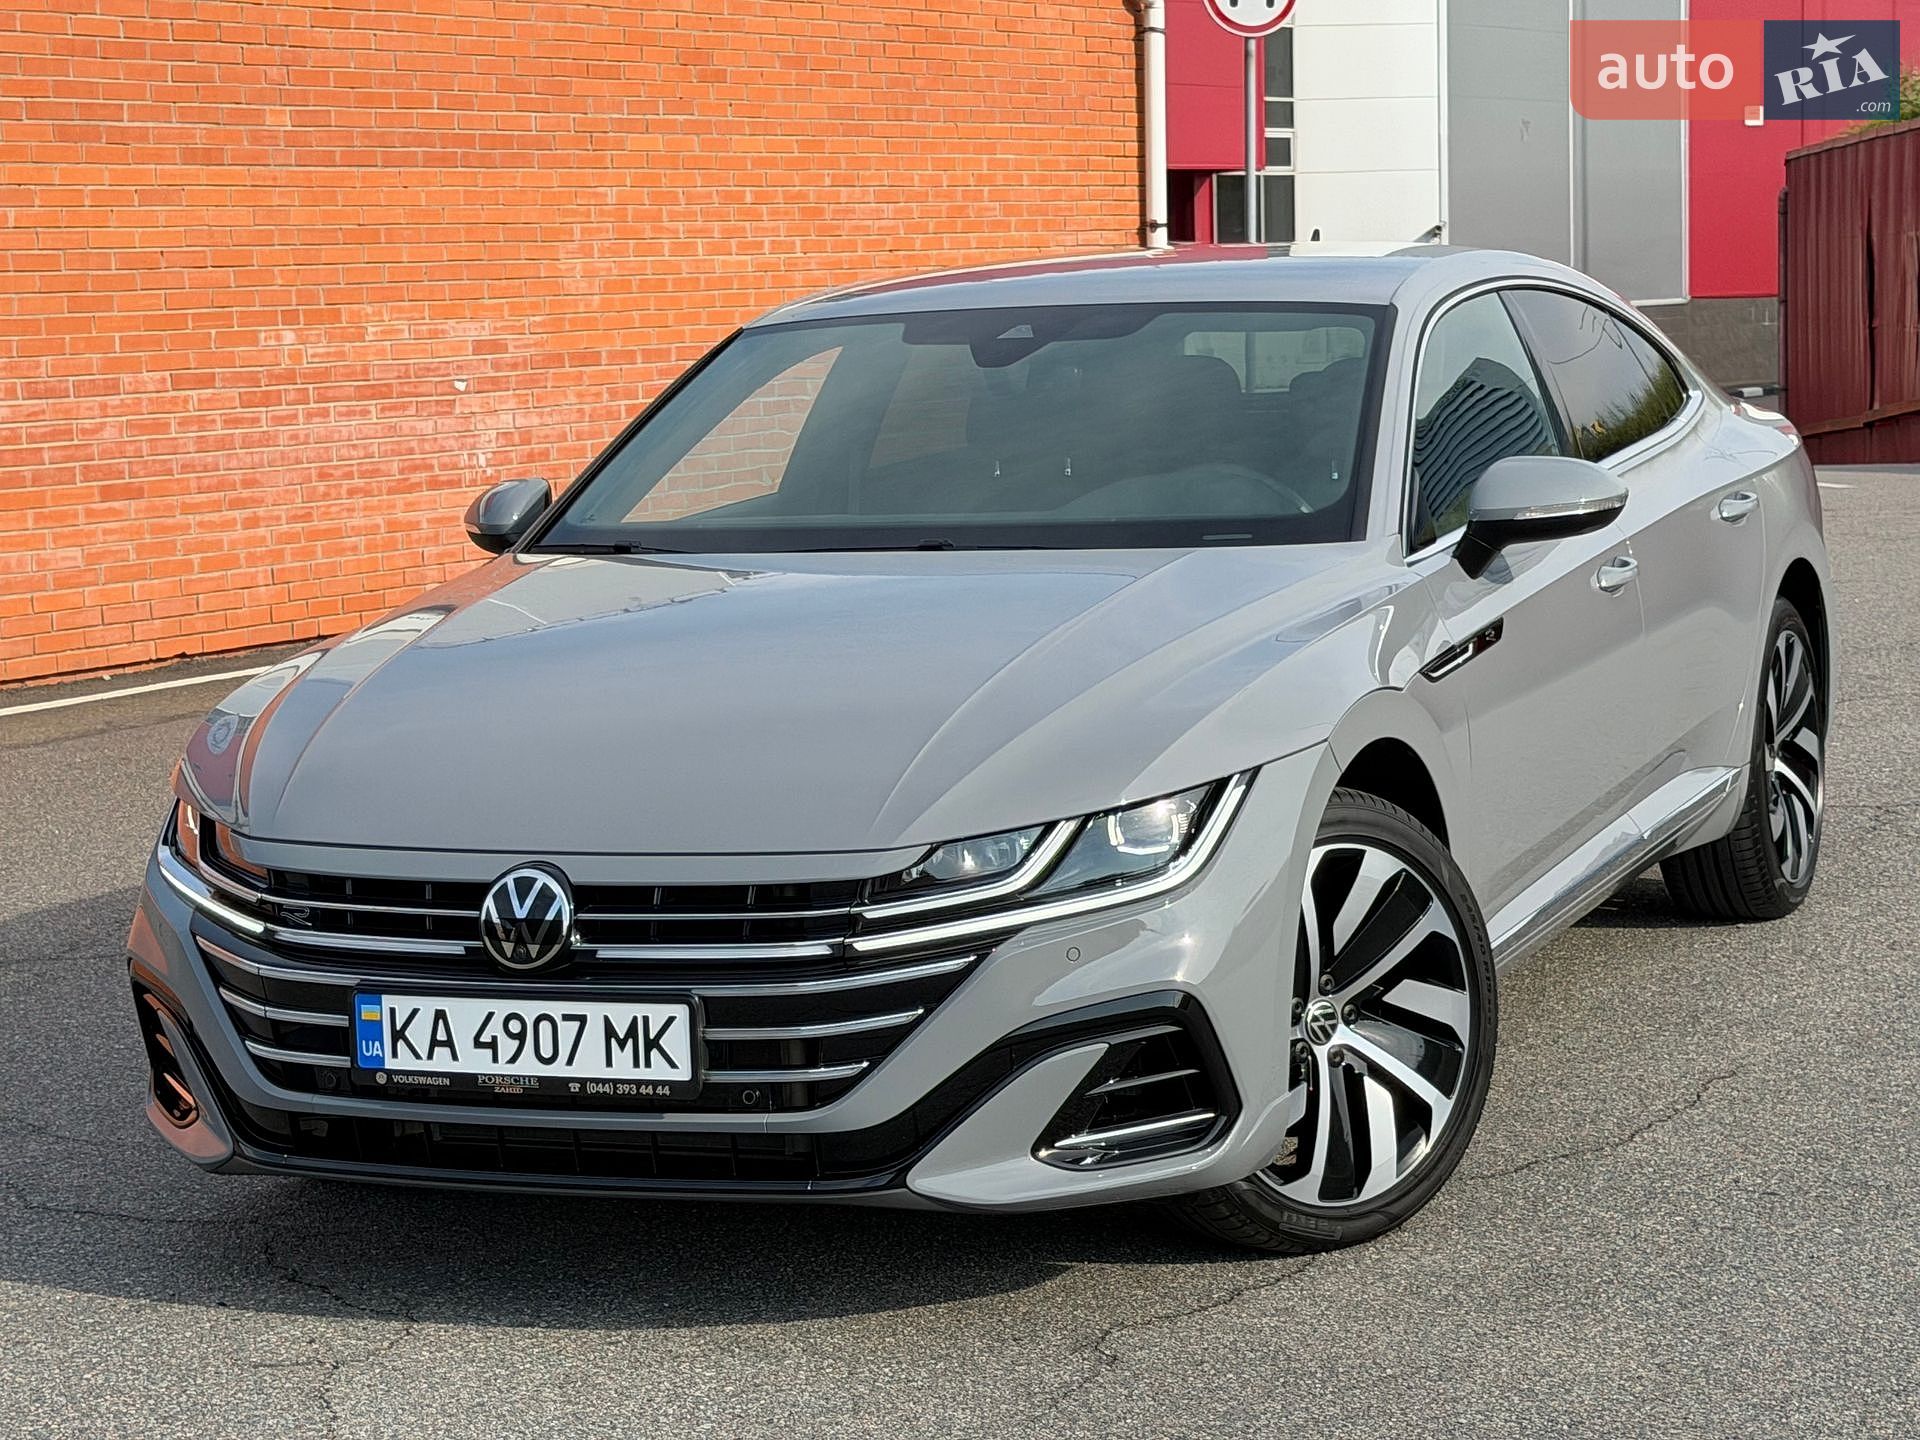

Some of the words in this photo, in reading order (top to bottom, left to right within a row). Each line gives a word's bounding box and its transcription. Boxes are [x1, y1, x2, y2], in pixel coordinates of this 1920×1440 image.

[388, 1006, 460, 1062] KA
[473, 1011, 589, 1067] 4907
[603, 1014, 680, 1070] MK
[362, 1040, 383, 1057] UA
[391, 1074, 450, 1086] VOLKSWAGEN
[477, 1075, 540, 1086] PORSCHE
[493, 1086, 524, 1094] ZAHID
[586, 1081, 614, 1095] (044)
[616, 1083, 637, 1095] 393
[639, 1084, 654, 1096] 44
[655, 1085, 671, 1097] 44
